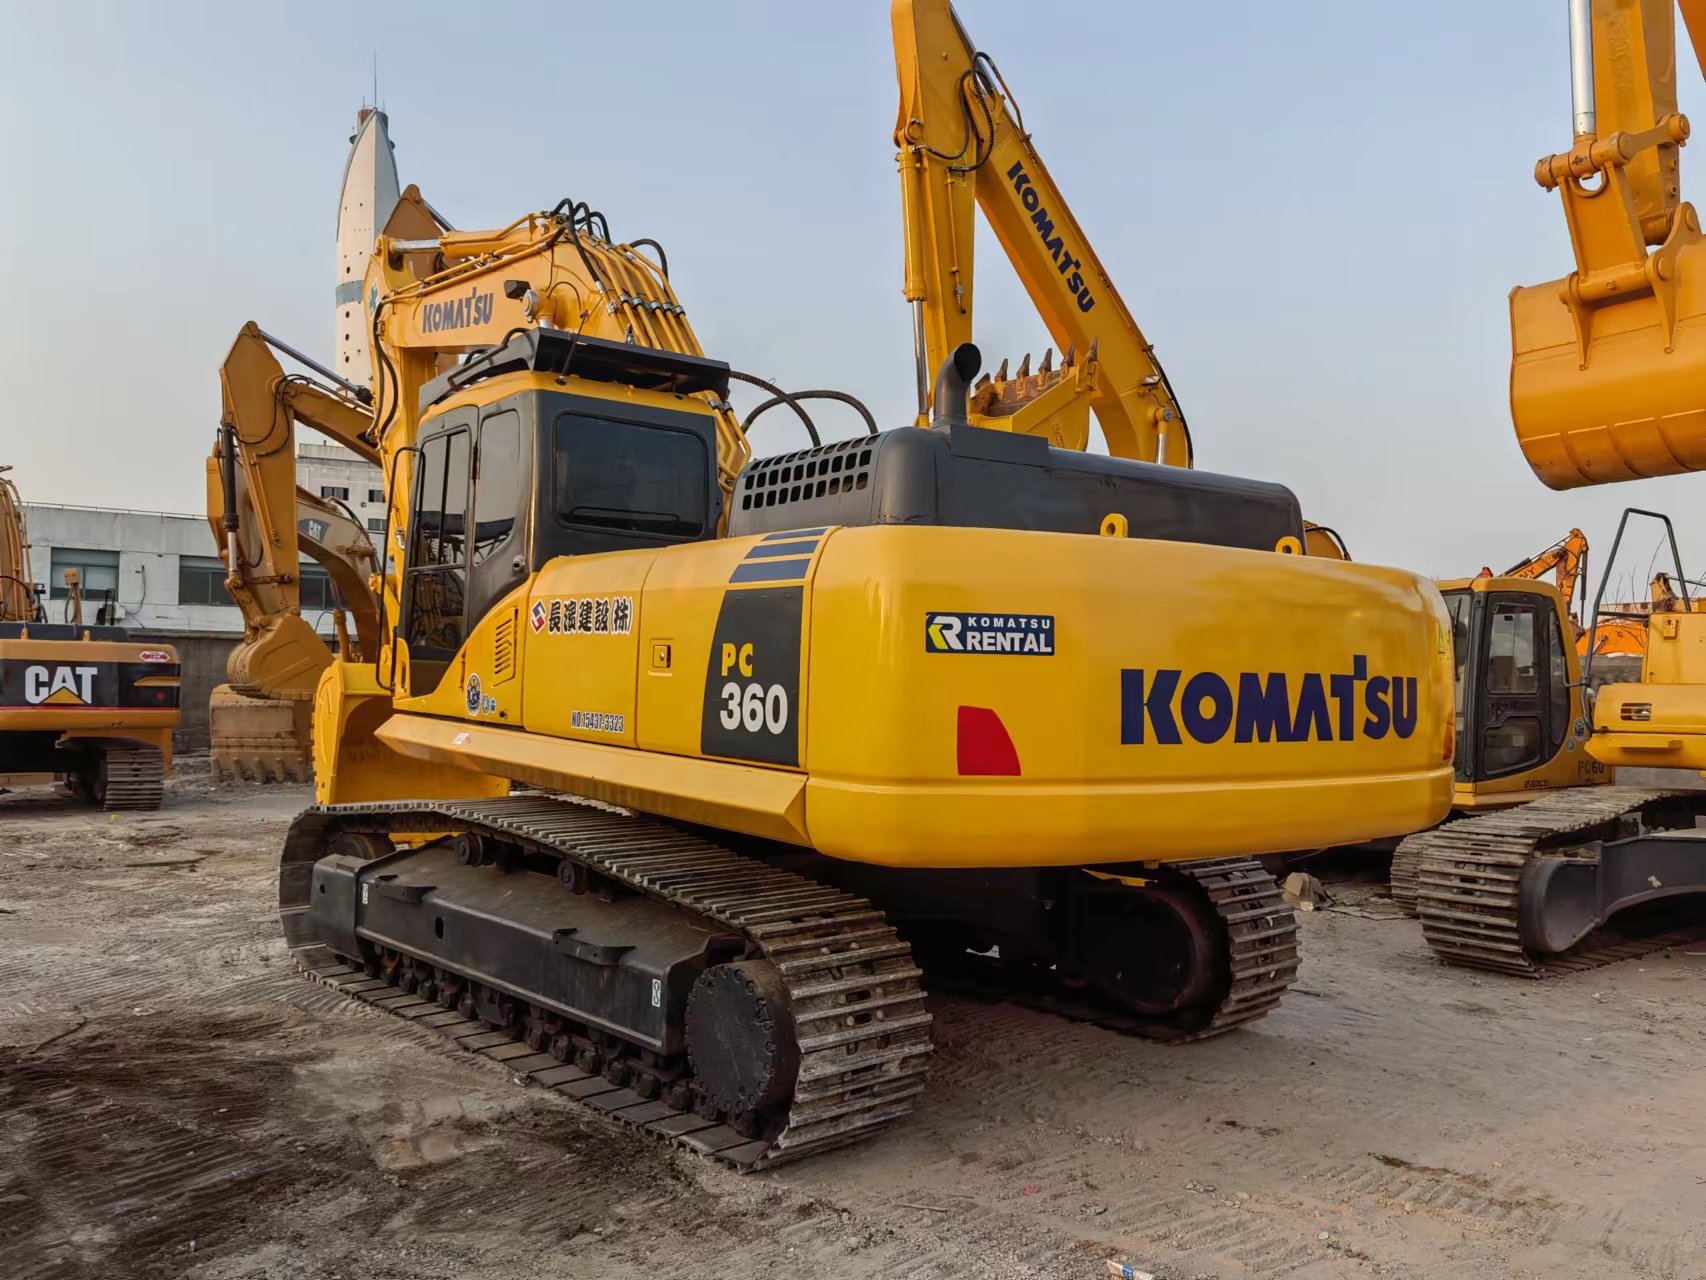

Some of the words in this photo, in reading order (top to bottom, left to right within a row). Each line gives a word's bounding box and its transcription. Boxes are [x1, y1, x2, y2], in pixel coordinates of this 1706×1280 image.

[1007, 160, 1096, 313] KOMATSU
[422, 286, 494, 334] KOMATSU
[966, 631, 1053, 653] RENTAL
[967, 616, 1050, 629] KOMATSU
[721, 642, 754, 677] PC
[25, 665, 98, 704] CAT
[1120, 654, 1418, 745] KOMATSU
[720, 681, 788, 735] 360
